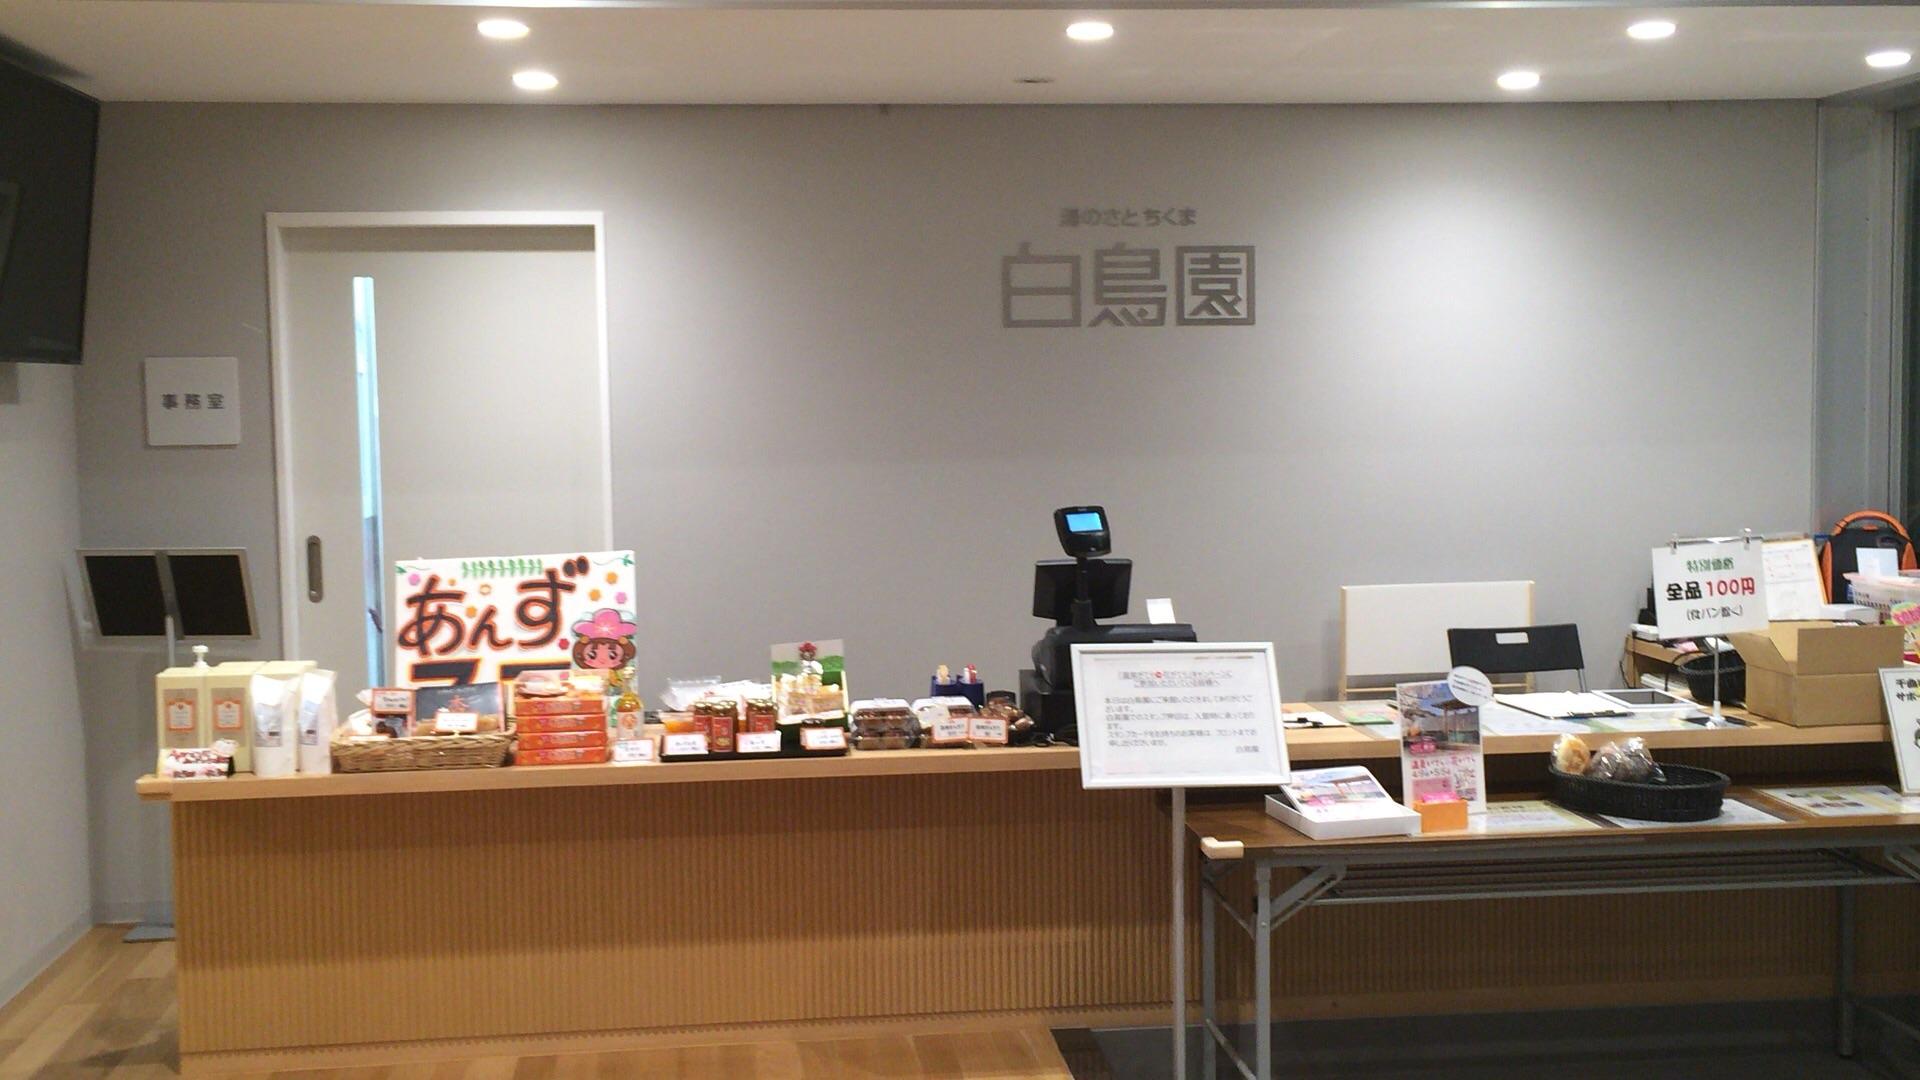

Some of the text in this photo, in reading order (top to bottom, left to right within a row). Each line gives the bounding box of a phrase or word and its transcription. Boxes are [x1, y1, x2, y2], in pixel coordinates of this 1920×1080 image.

[1001, 242, 1256, 328] 白鳥園
[161, 393, 225, 410] 事務室
[1686, 557, 1735, 573] 特別価格
[398, 555, 591, 657] あんず
